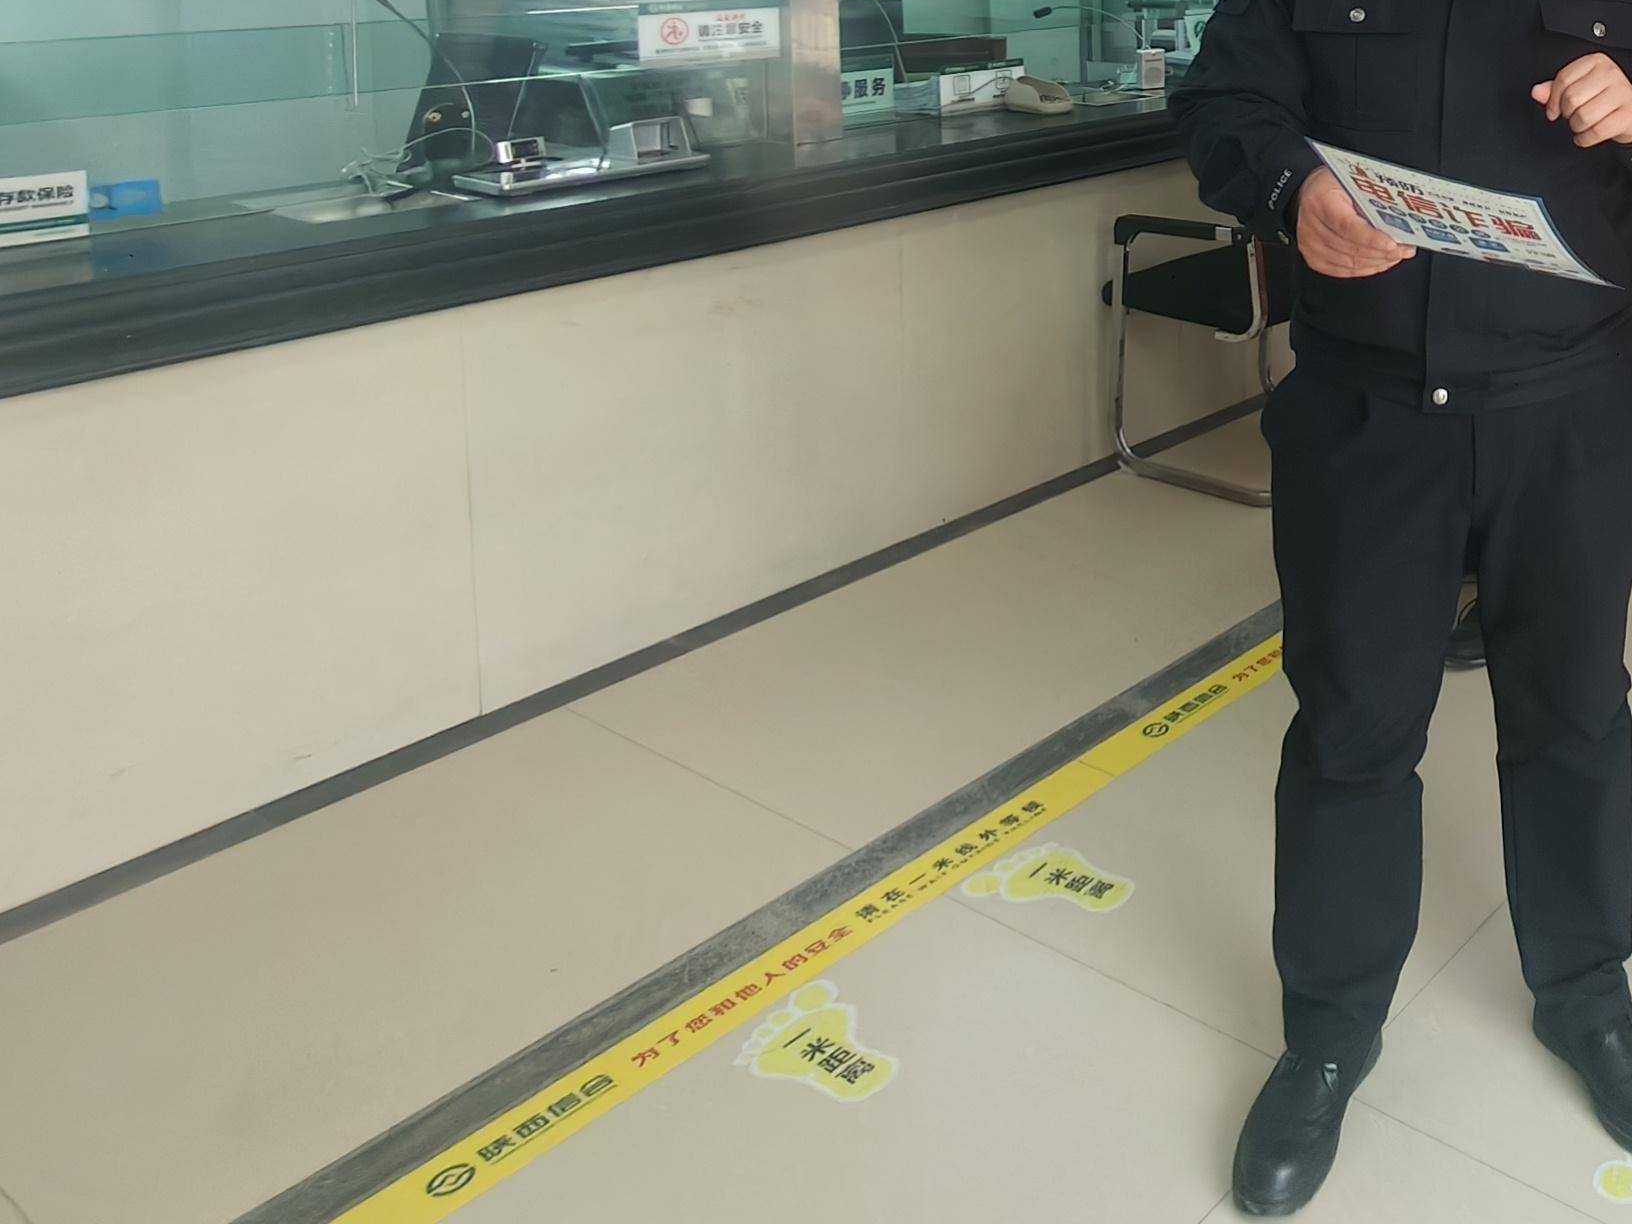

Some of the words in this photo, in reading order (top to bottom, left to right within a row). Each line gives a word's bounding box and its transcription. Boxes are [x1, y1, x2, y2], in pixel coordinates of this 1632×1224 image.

[1268, 169, 1293, 210] POLICE
[1350, 174, 1542, 241] 电信诈骗
[1026, 859, 1117, 901] 一米距离
[477, 1074, 619, 1163] 陕西信合
[631, 923, 854, 1069] 为了您和他人的安全
[782, 1027, 876, 1086] 一米距离
